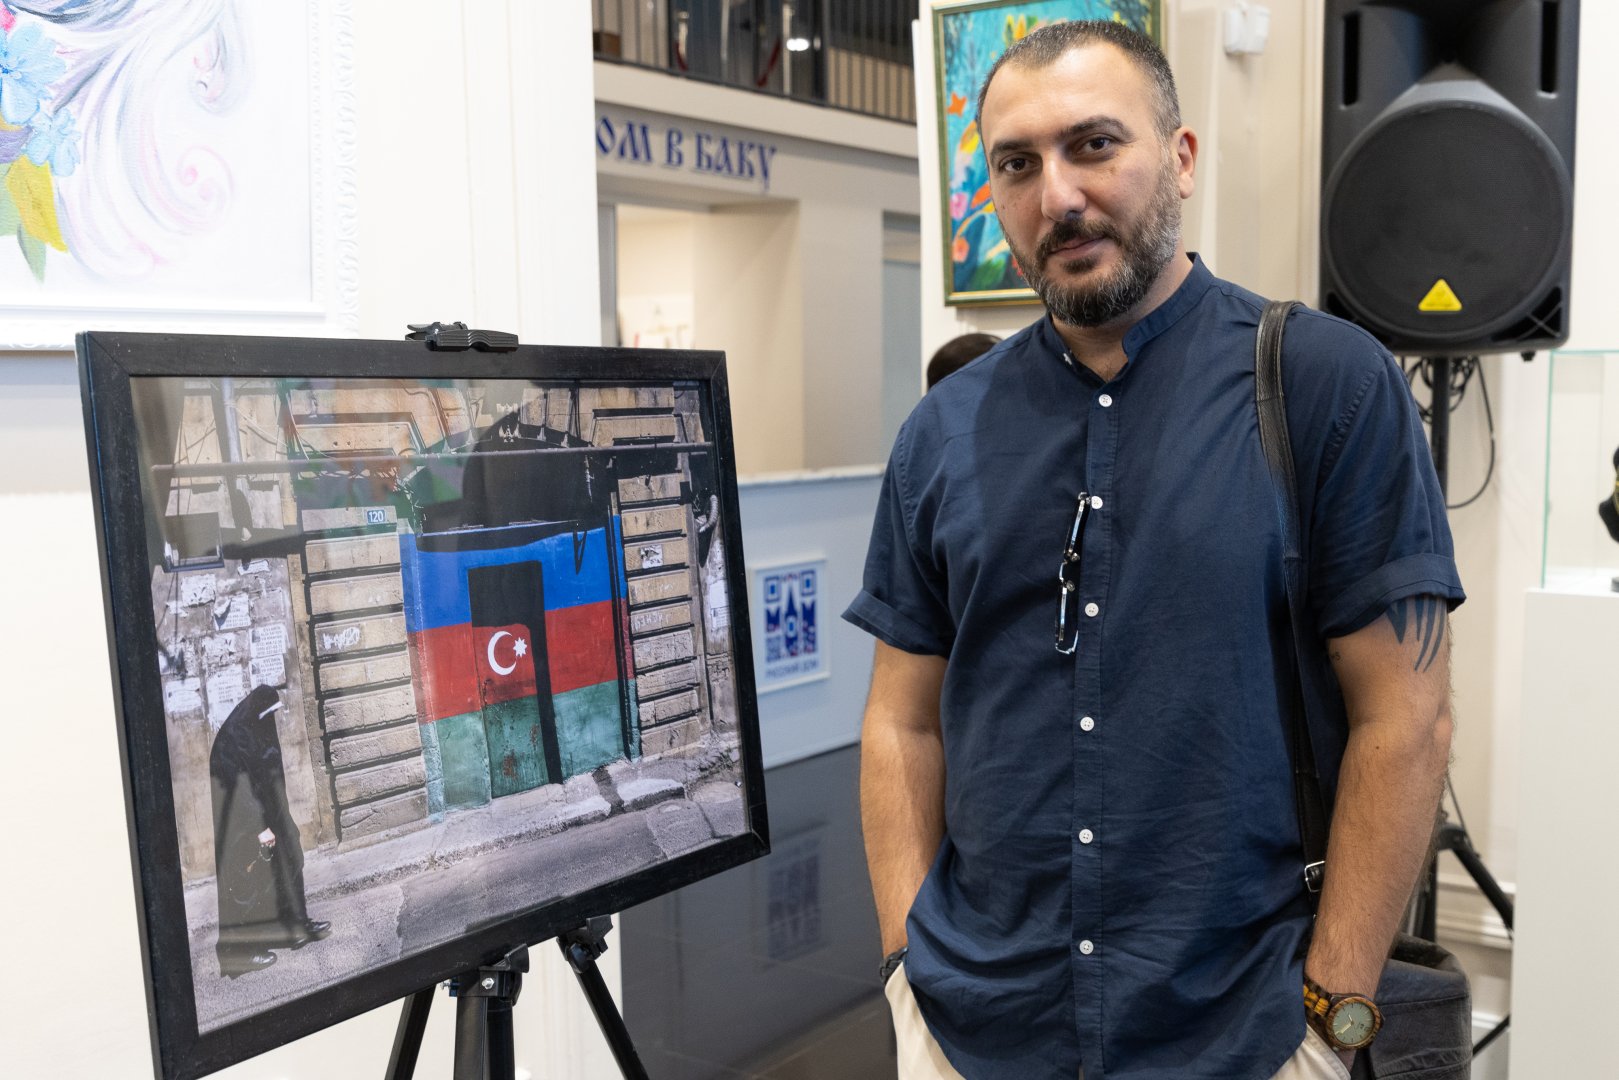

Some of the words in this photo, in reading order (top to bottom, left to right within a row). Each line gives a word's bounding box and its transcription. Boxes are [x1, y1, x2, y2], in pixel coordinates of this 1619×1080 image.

[665, 128, 683, 167] В
[694, 132, 777, 191] БАКУ
[369, 511, 384, 522] 120
